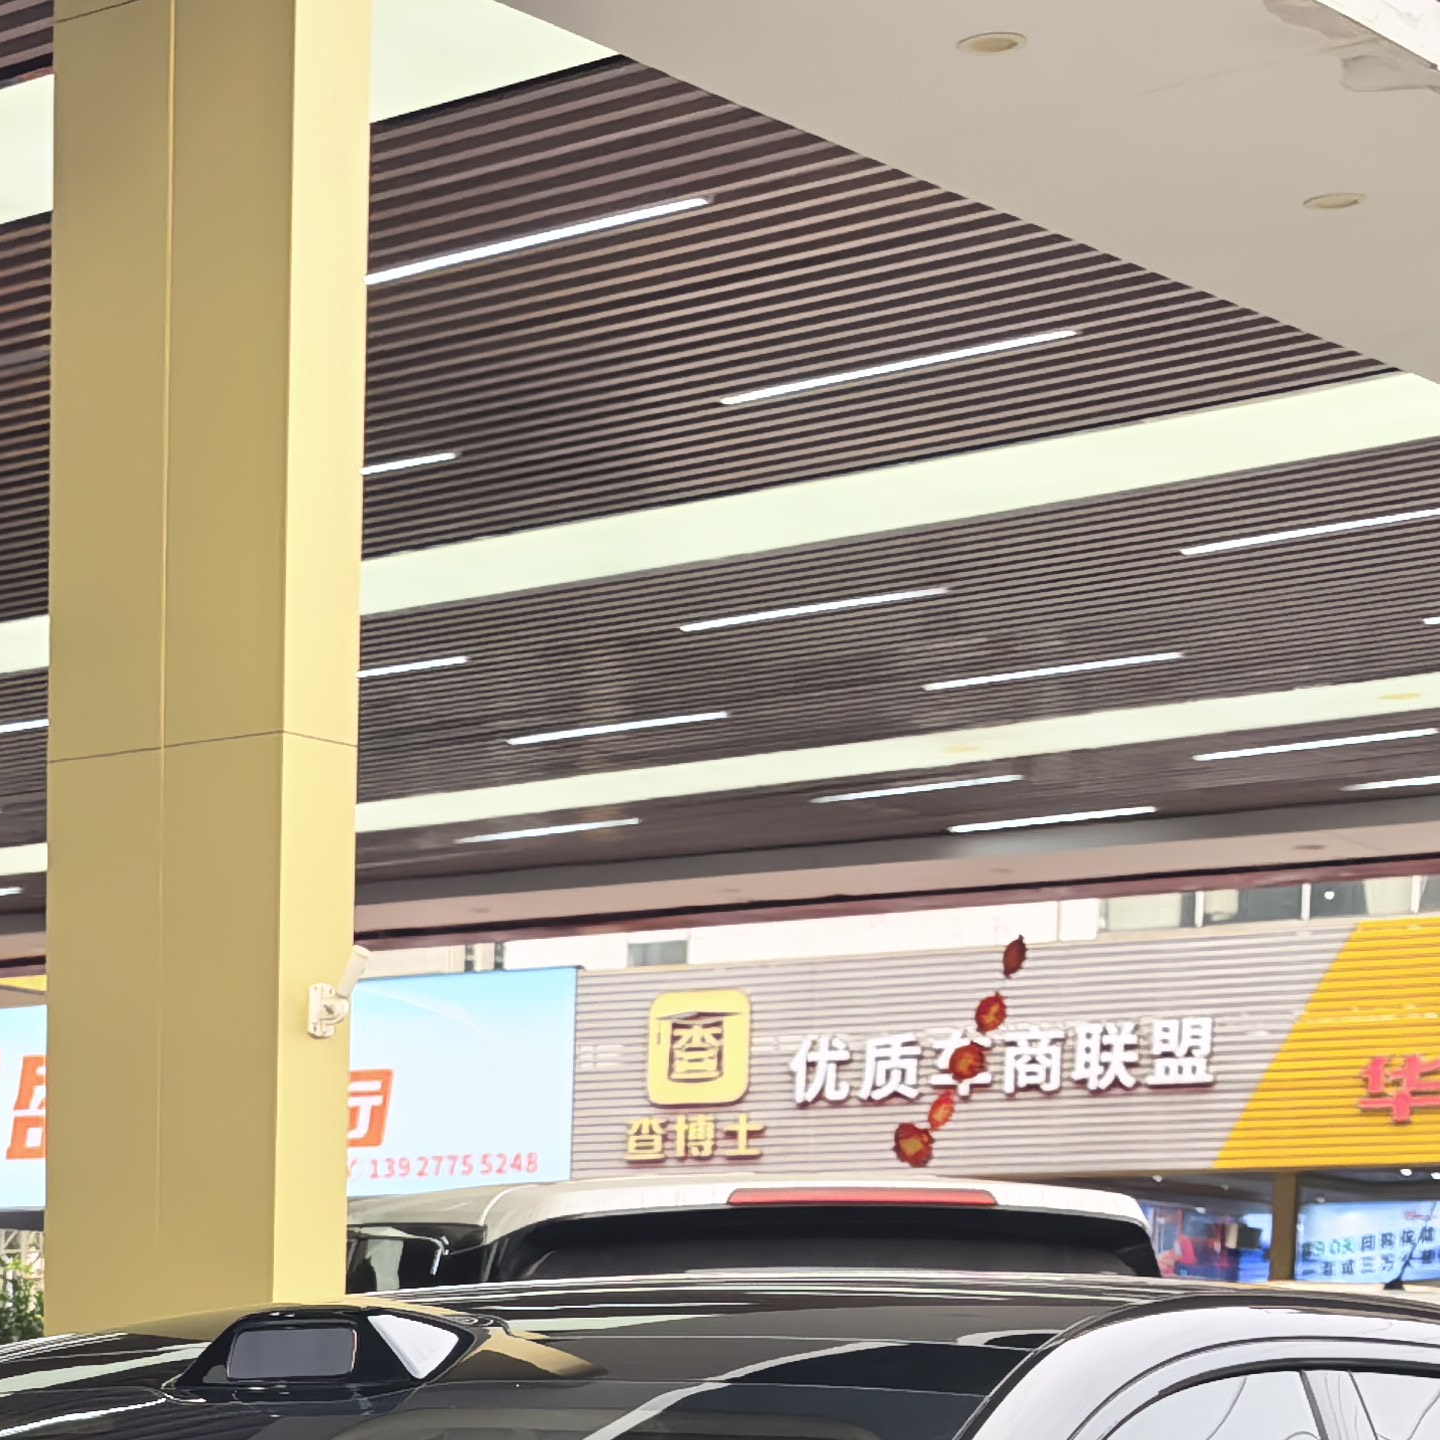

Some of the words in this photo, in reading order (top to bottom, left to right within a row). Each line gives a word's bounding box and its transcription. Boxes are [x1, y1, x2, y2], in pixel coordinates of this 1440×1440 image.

[626, 1113, 765, 1162] 查博士
[369, 1157, 411, 1180] 139
[416, 1153, 474, 1177] 2775
[479, 1151, 539, 1175] 5248
